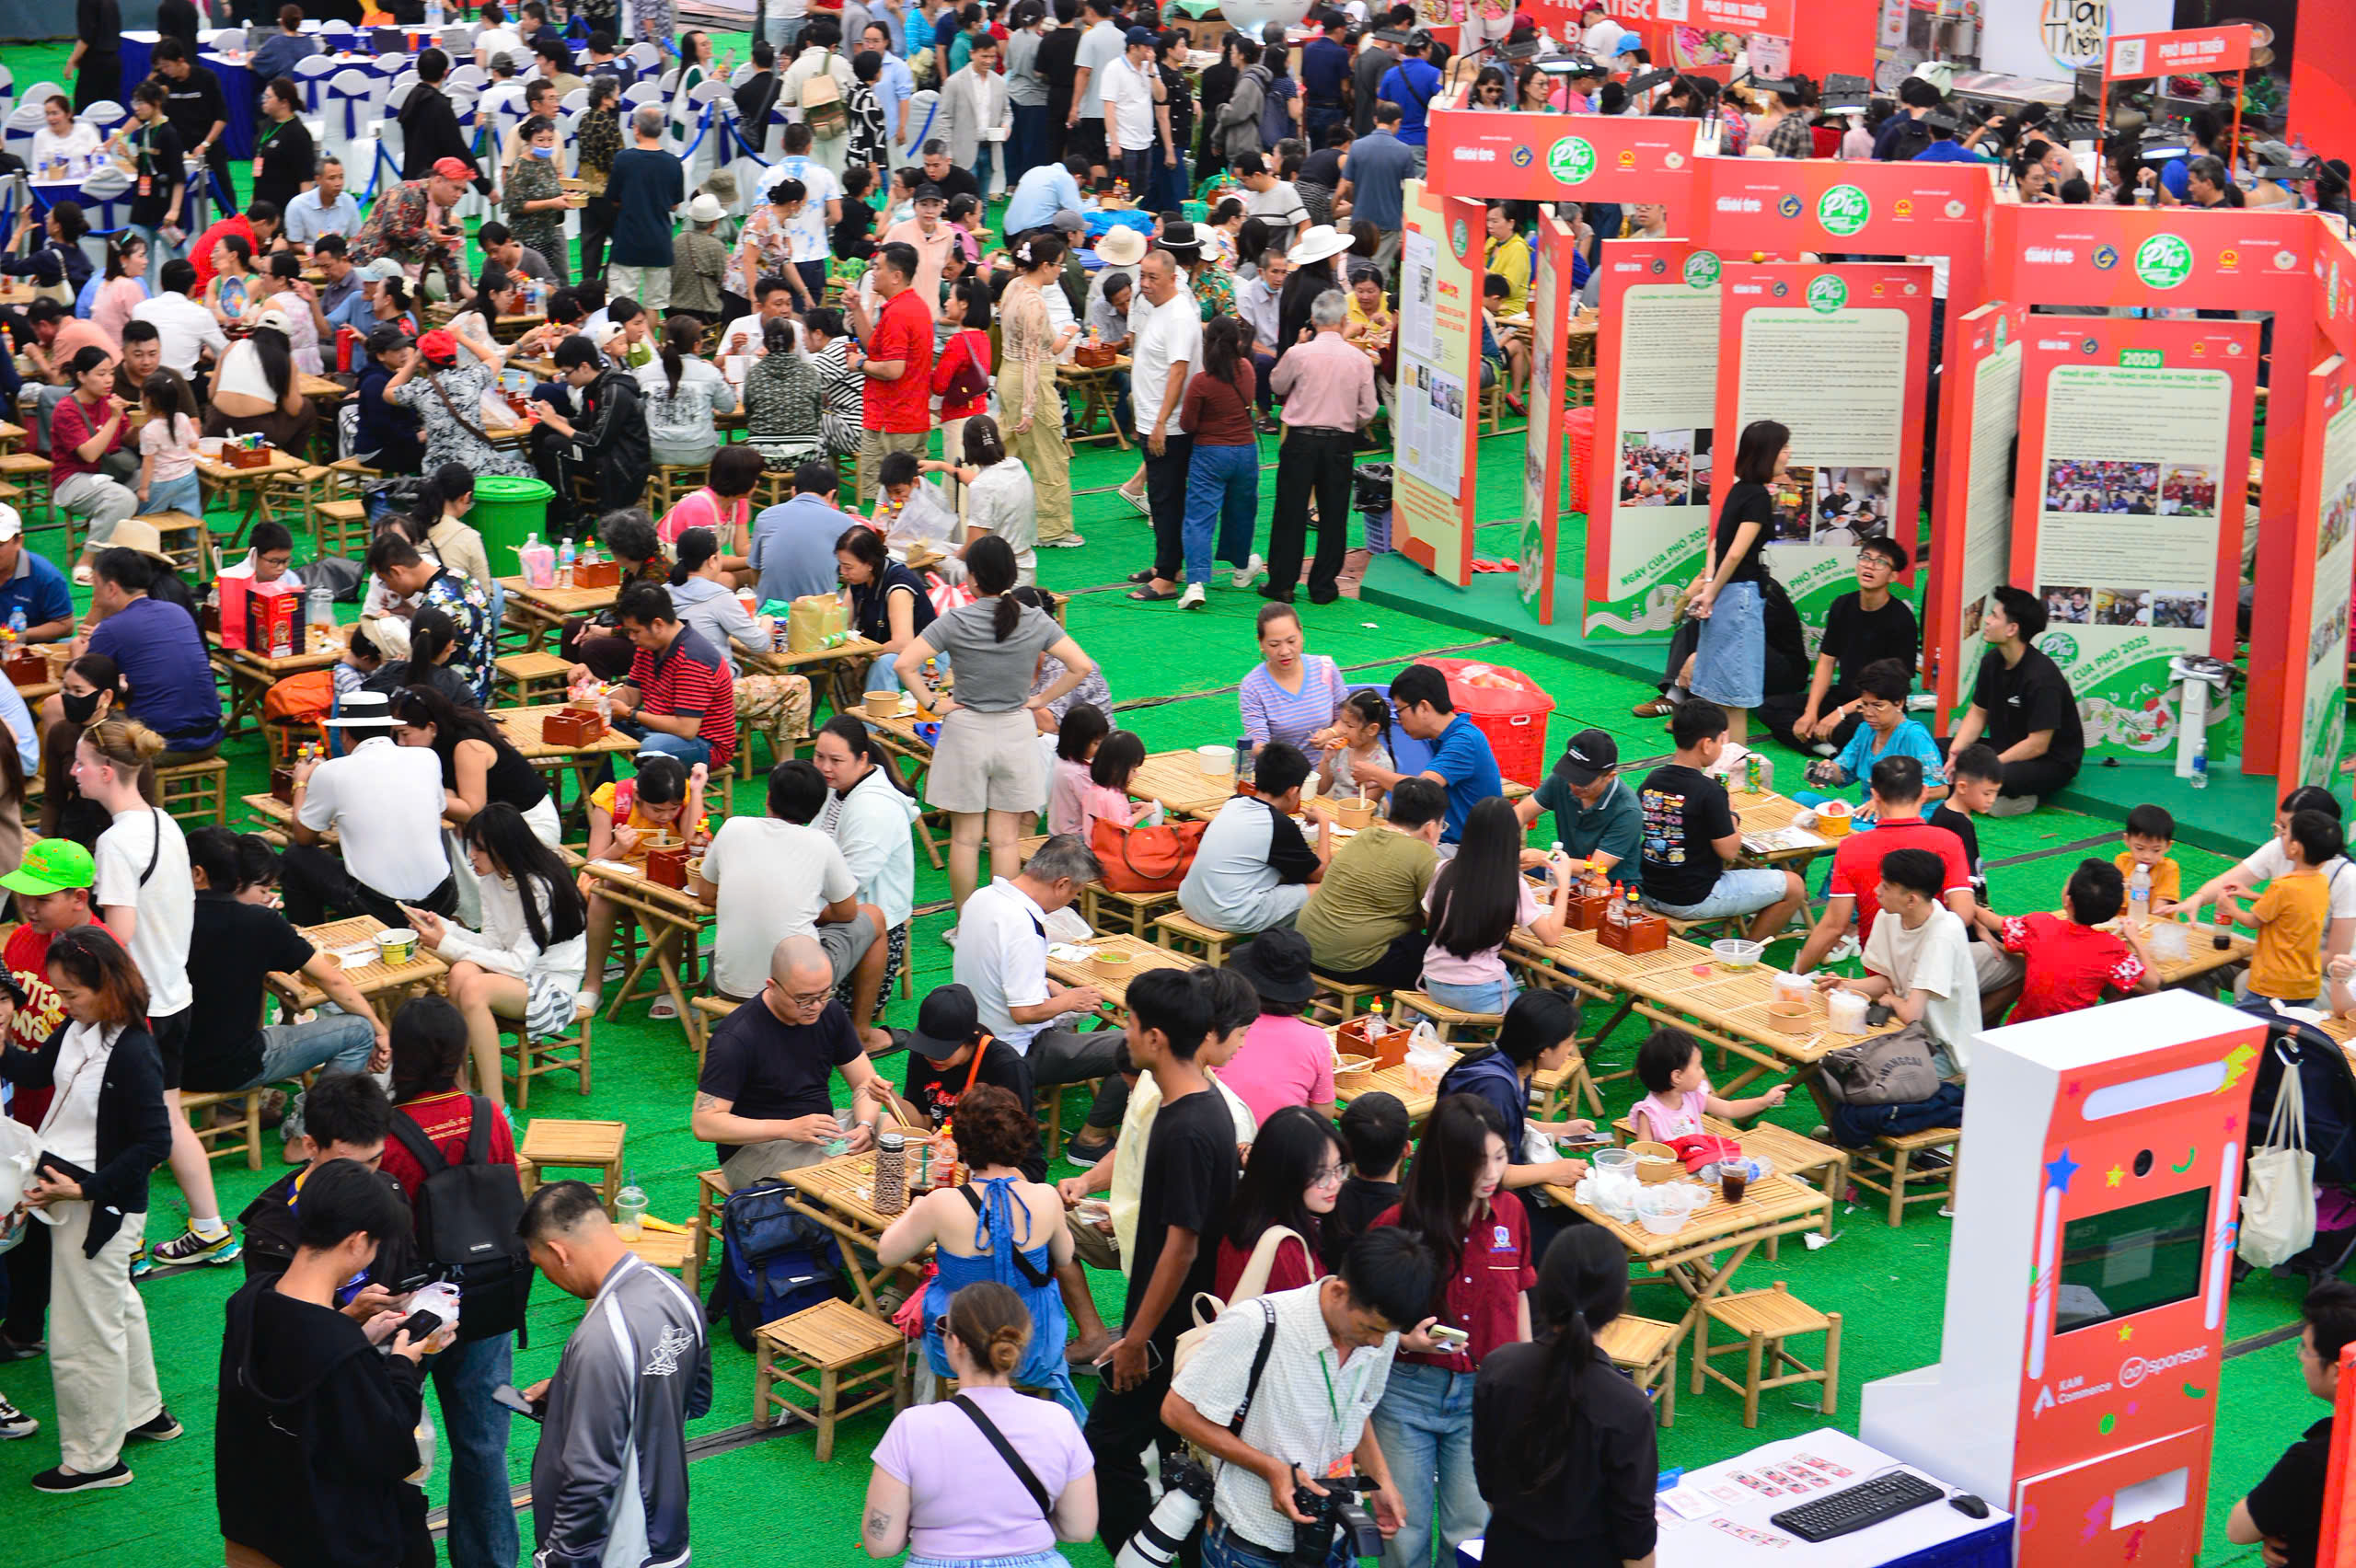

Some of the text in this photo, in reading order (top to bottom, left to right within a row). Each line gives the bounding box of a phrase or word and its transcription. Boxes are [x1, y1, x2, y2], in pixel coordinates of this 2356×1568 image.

[2122, 351, 2161, 366] 2020
[1811, 557, 1839, 576] 2025
[2119, 634, 2151, 654] 2025
[2060, 1375, 2083, 1390] KAM
[2058, 1382, 2113, 1405] Commerce
